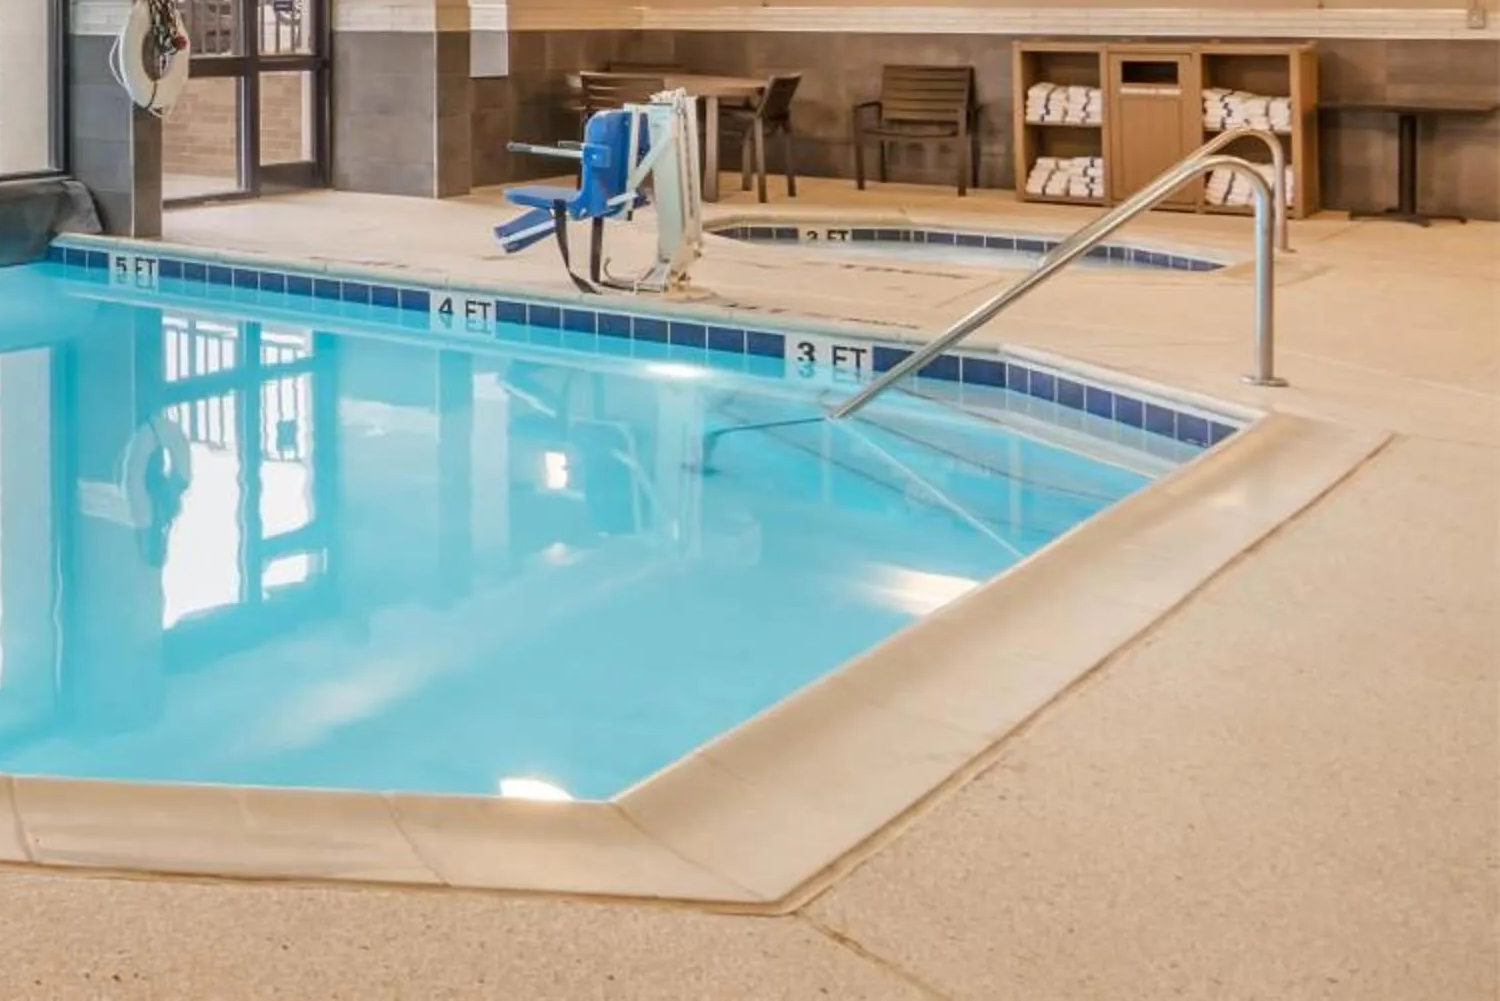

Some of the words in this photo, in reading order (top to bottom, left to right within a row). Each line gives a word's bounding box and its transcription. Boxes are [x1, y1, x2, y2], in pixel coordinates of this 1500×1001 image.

[827, 230, 849, 241] FT
[115, 256, 127, 274] 5
[135, 256, 156, 275] FT
[438, 297, 454, 316] 4
[465, 300, 492, 319] FT
[797, 341, 816, 363] 3
[832, 345, 867, 369] FT
